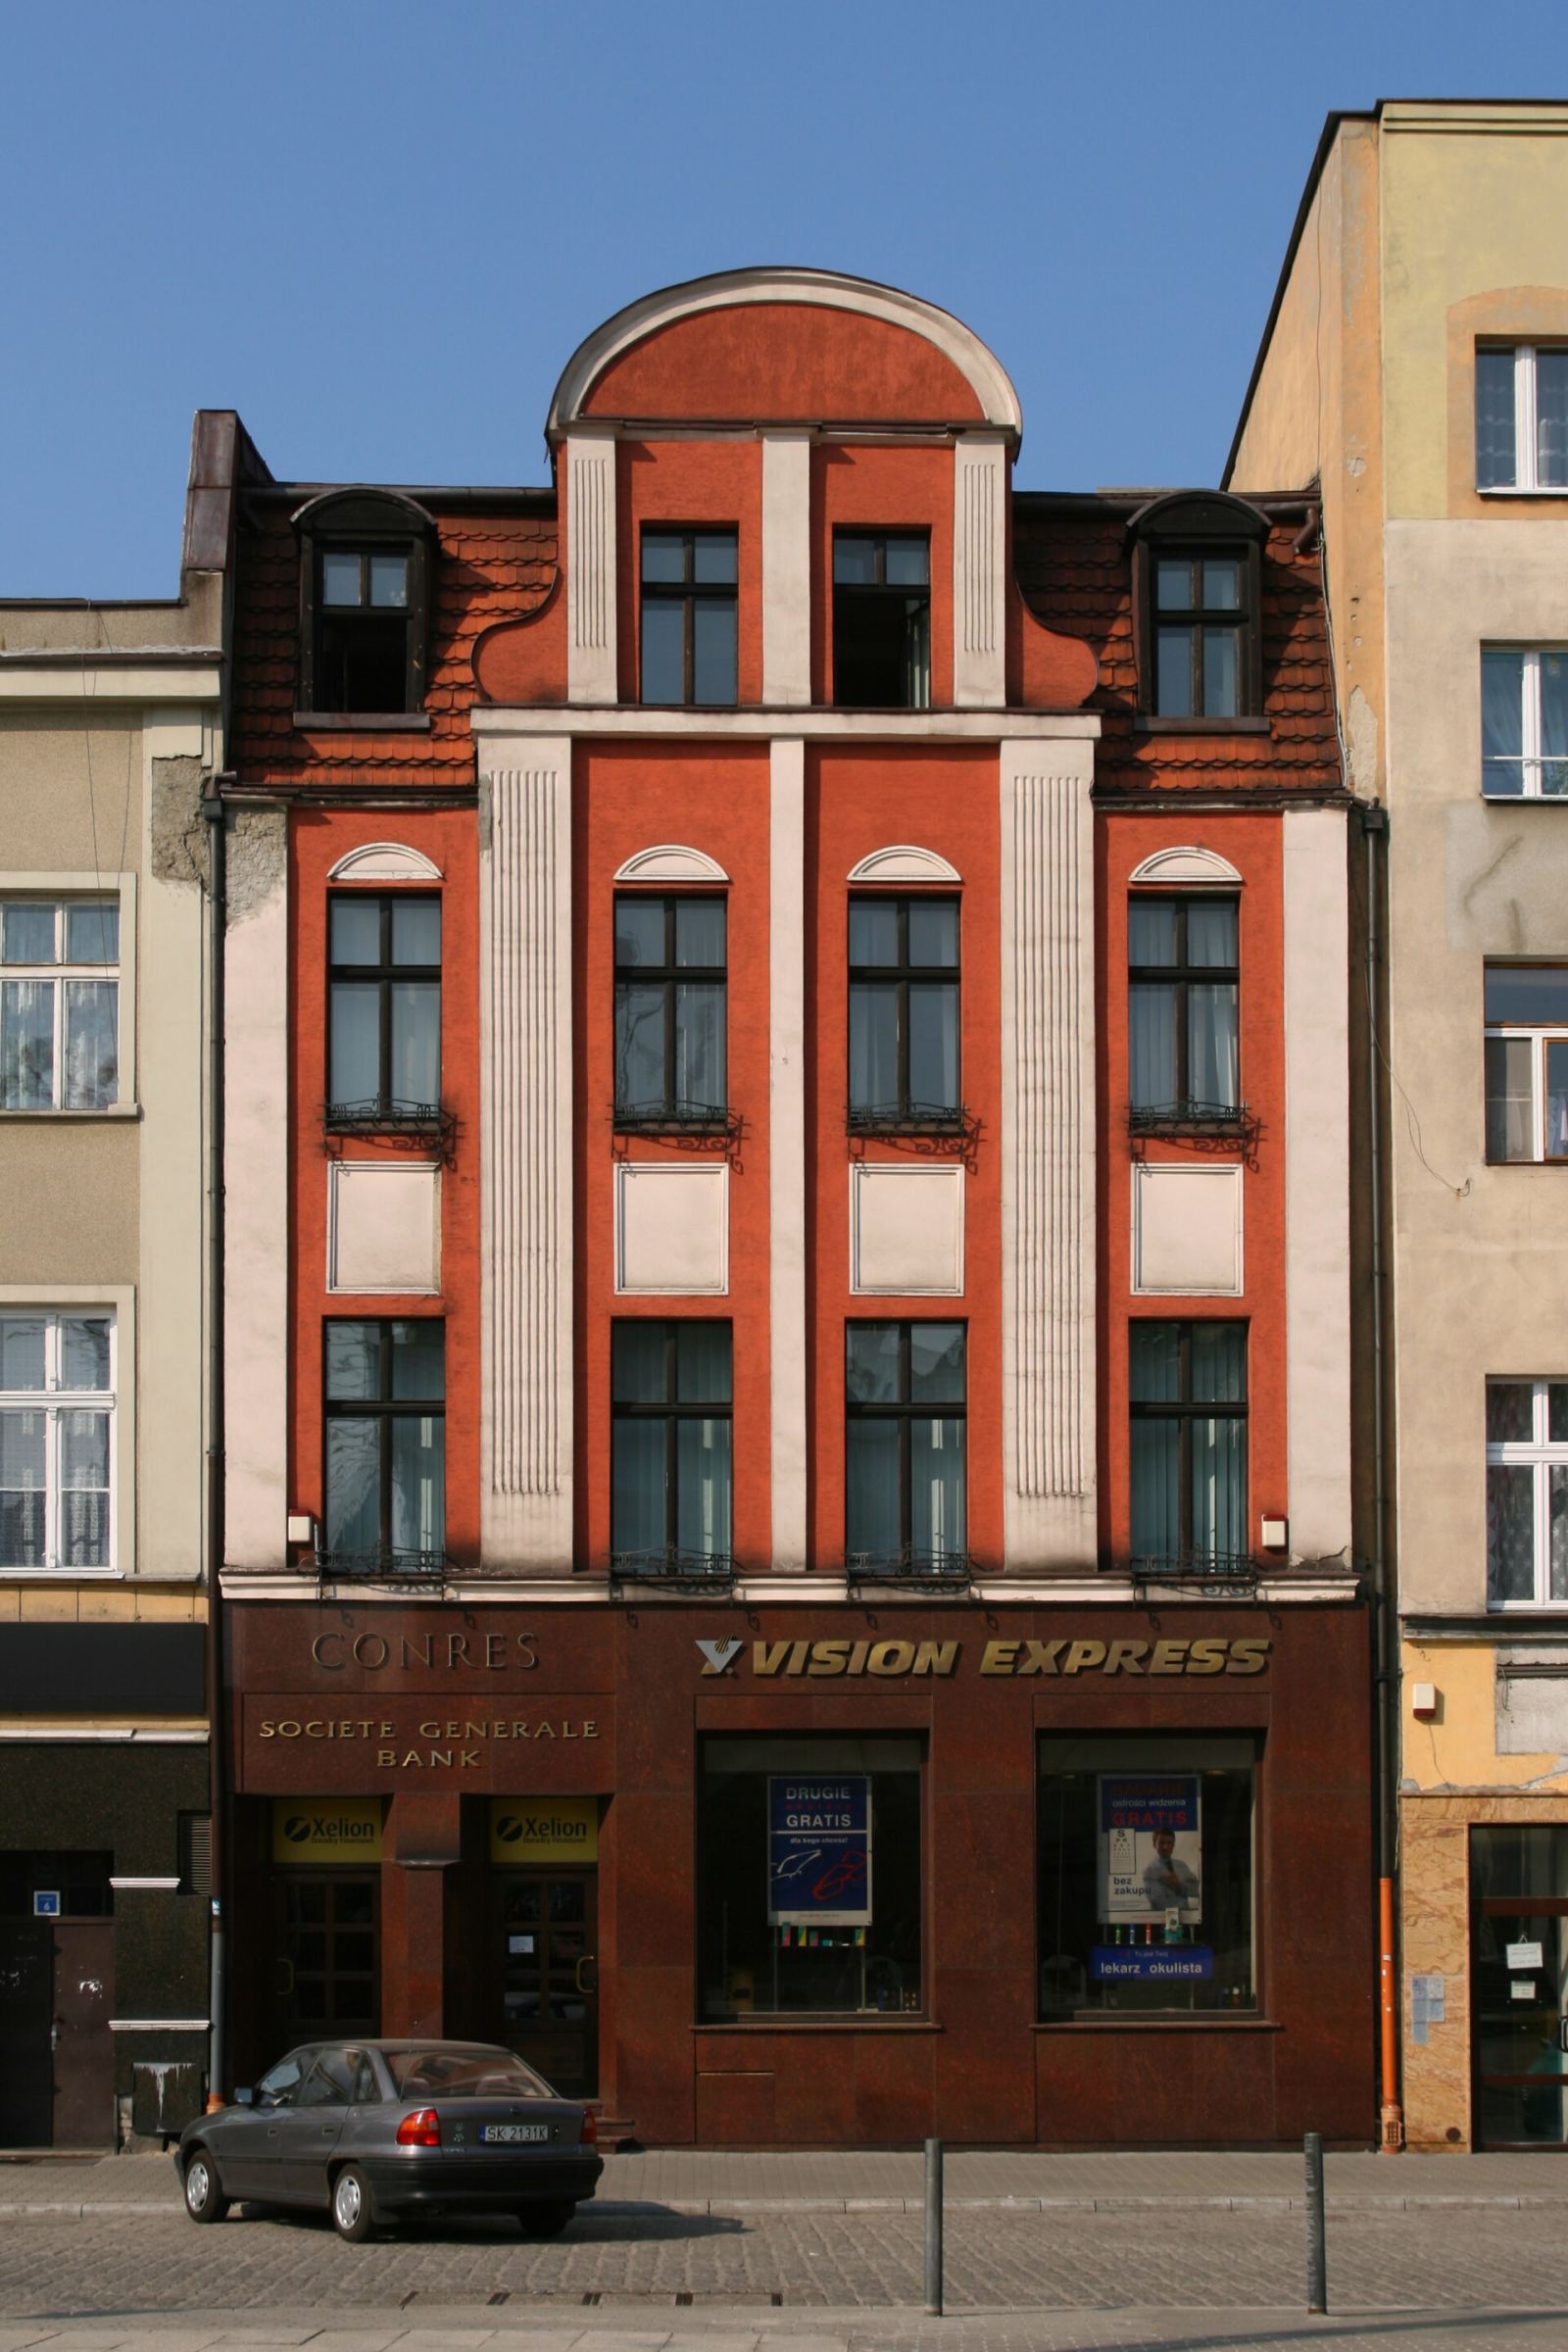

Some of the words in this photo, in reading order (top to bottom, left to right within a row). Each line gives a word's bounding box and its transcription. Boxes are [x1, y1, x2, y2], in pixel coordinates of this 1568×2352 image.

[311, 1632, 539, 1670] CONRES
[753, 1640, 960, 1675] VISION
[979, 1639, 1271, 1675] EXPRESS
[259, 1720, 396, 1739] SOCIETE
[418, 1720, 600, 1739] GENERALE
[376, 1749, 482, 1768] BANK
[786, 1787, 852, 1800] DRUGIE
[1149, 1797, 1186, 1808] widzenia
[786, 1814, 852, 1828] GRATIS
[1113, 1810, 1188, 1826] GRATIS
[313, 1817, 374, 1838] Xelion
[525, 1817, 587, 1838] Xelion
[1113, 1877, 1133, 1886] bez
[1100, 1962, 1142, 1974] lekarz
[1149, 1962, 1203, 1974] okulista
[487, 2127, 507, 2140] SK
[510, 2127, 547, 2140] 2131K
